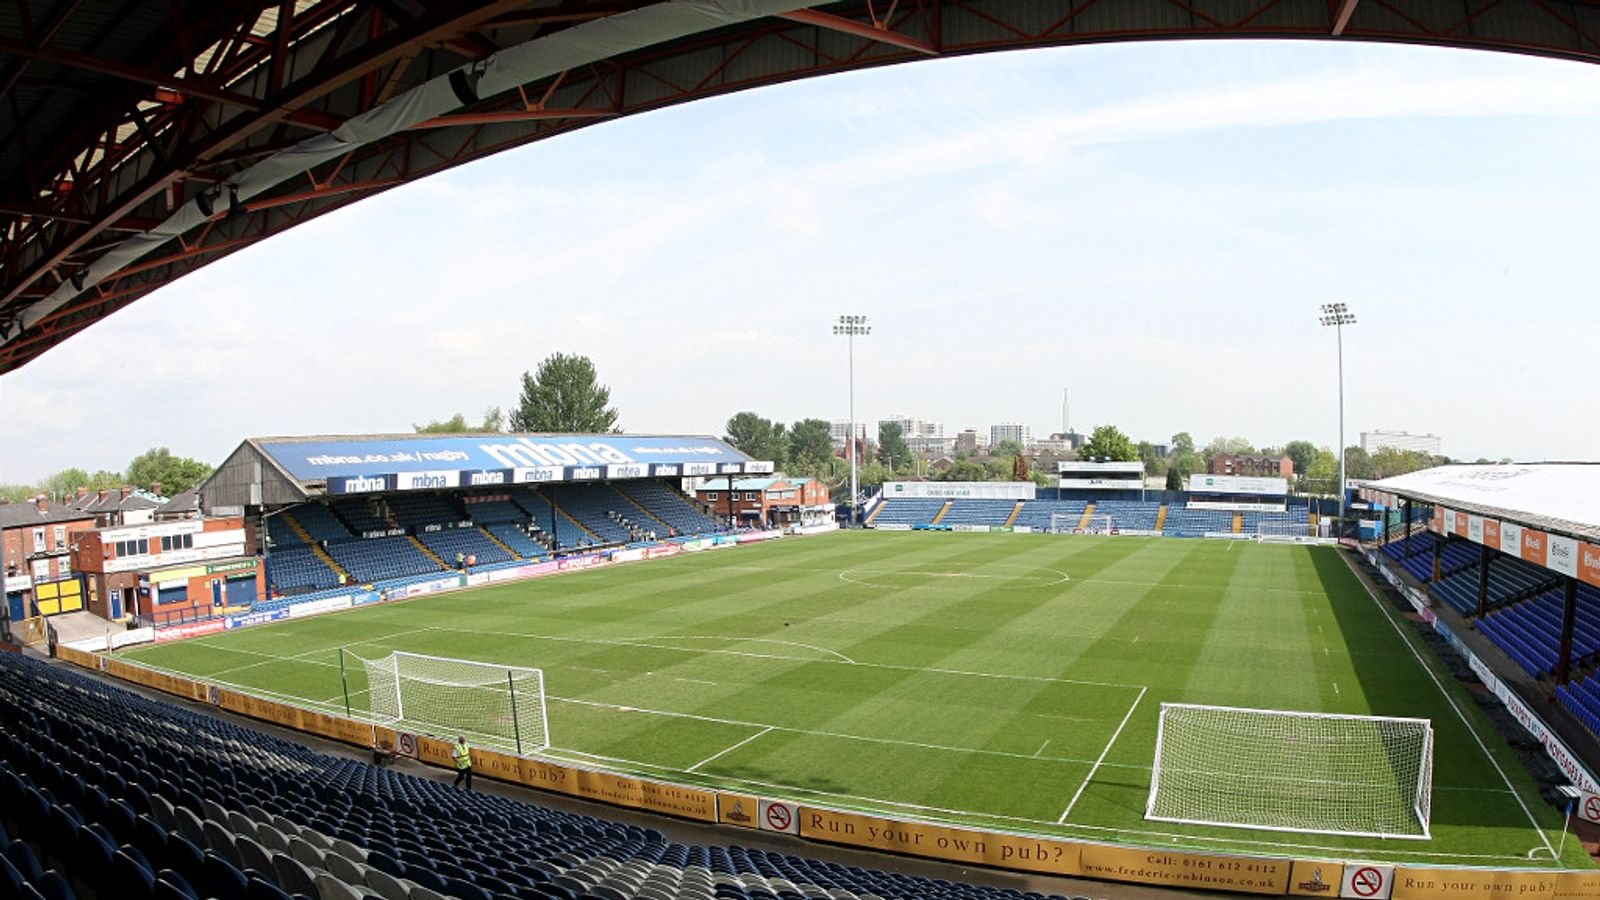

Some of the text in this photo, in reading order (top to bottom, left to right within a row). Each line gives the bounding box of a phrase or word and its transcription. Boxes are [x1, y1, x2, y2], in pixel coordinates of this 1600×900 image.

[306, 450, 469, 465] mbna.co.uk/rugby
[479, 437, 635, 468] mbna
[471, 470, 504, 485] mbna
[525, 468, 553, 481] mbna
[573, 466, 600, 479] mbna
[345, 475, 385, 494] mbna
[412, 473, 446, 488] mbna
[423, 742, 448, 759] Run
[492, 760, 522, 774] own
[529, 767, 566, 784] pub?
[811, 813, 1064, 864] Run your own pub?
[1146, 855, 1278, 874] Call: 0161 612 4112
[1404, 878, 1435, 889] Run
[1441, 881, 1476, 892] your
[1484, 883, 1513, 892] own
